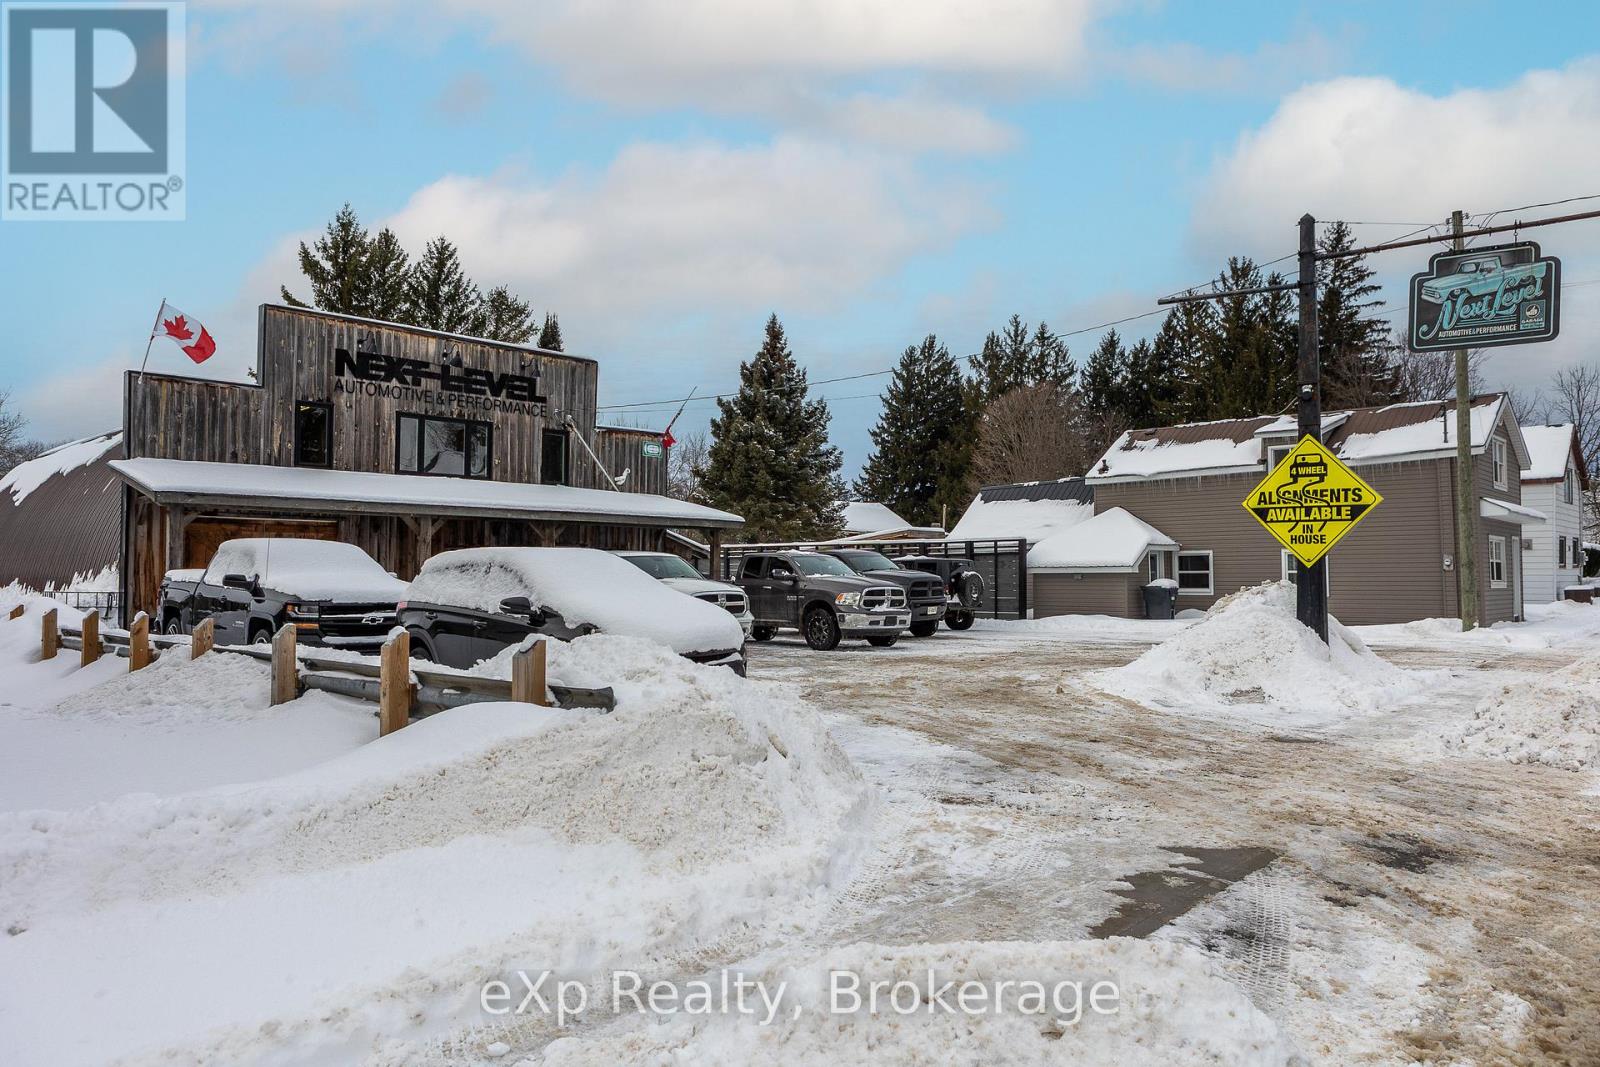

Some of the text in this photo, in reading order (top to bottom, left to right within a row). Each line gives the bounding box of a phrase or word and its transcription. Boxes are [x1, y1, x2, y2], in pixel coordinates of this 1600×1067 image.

[1419, 275, 1544, 340] Next Level
[440, 364, 547, 404] LEVEL
[334, 378, 548, 418] AUTOMOTIVE & PERFORMANCE
[1290, 466, 1326, 475] 4 WHEEL
[1257, 488, 1362, 505] ALIGNMENTS
[1266, 507, 1351, 521] AVAILABLE
[1302, 524, 1314, 534] IN
[1290, 534, 1327, 545] HOUSE
